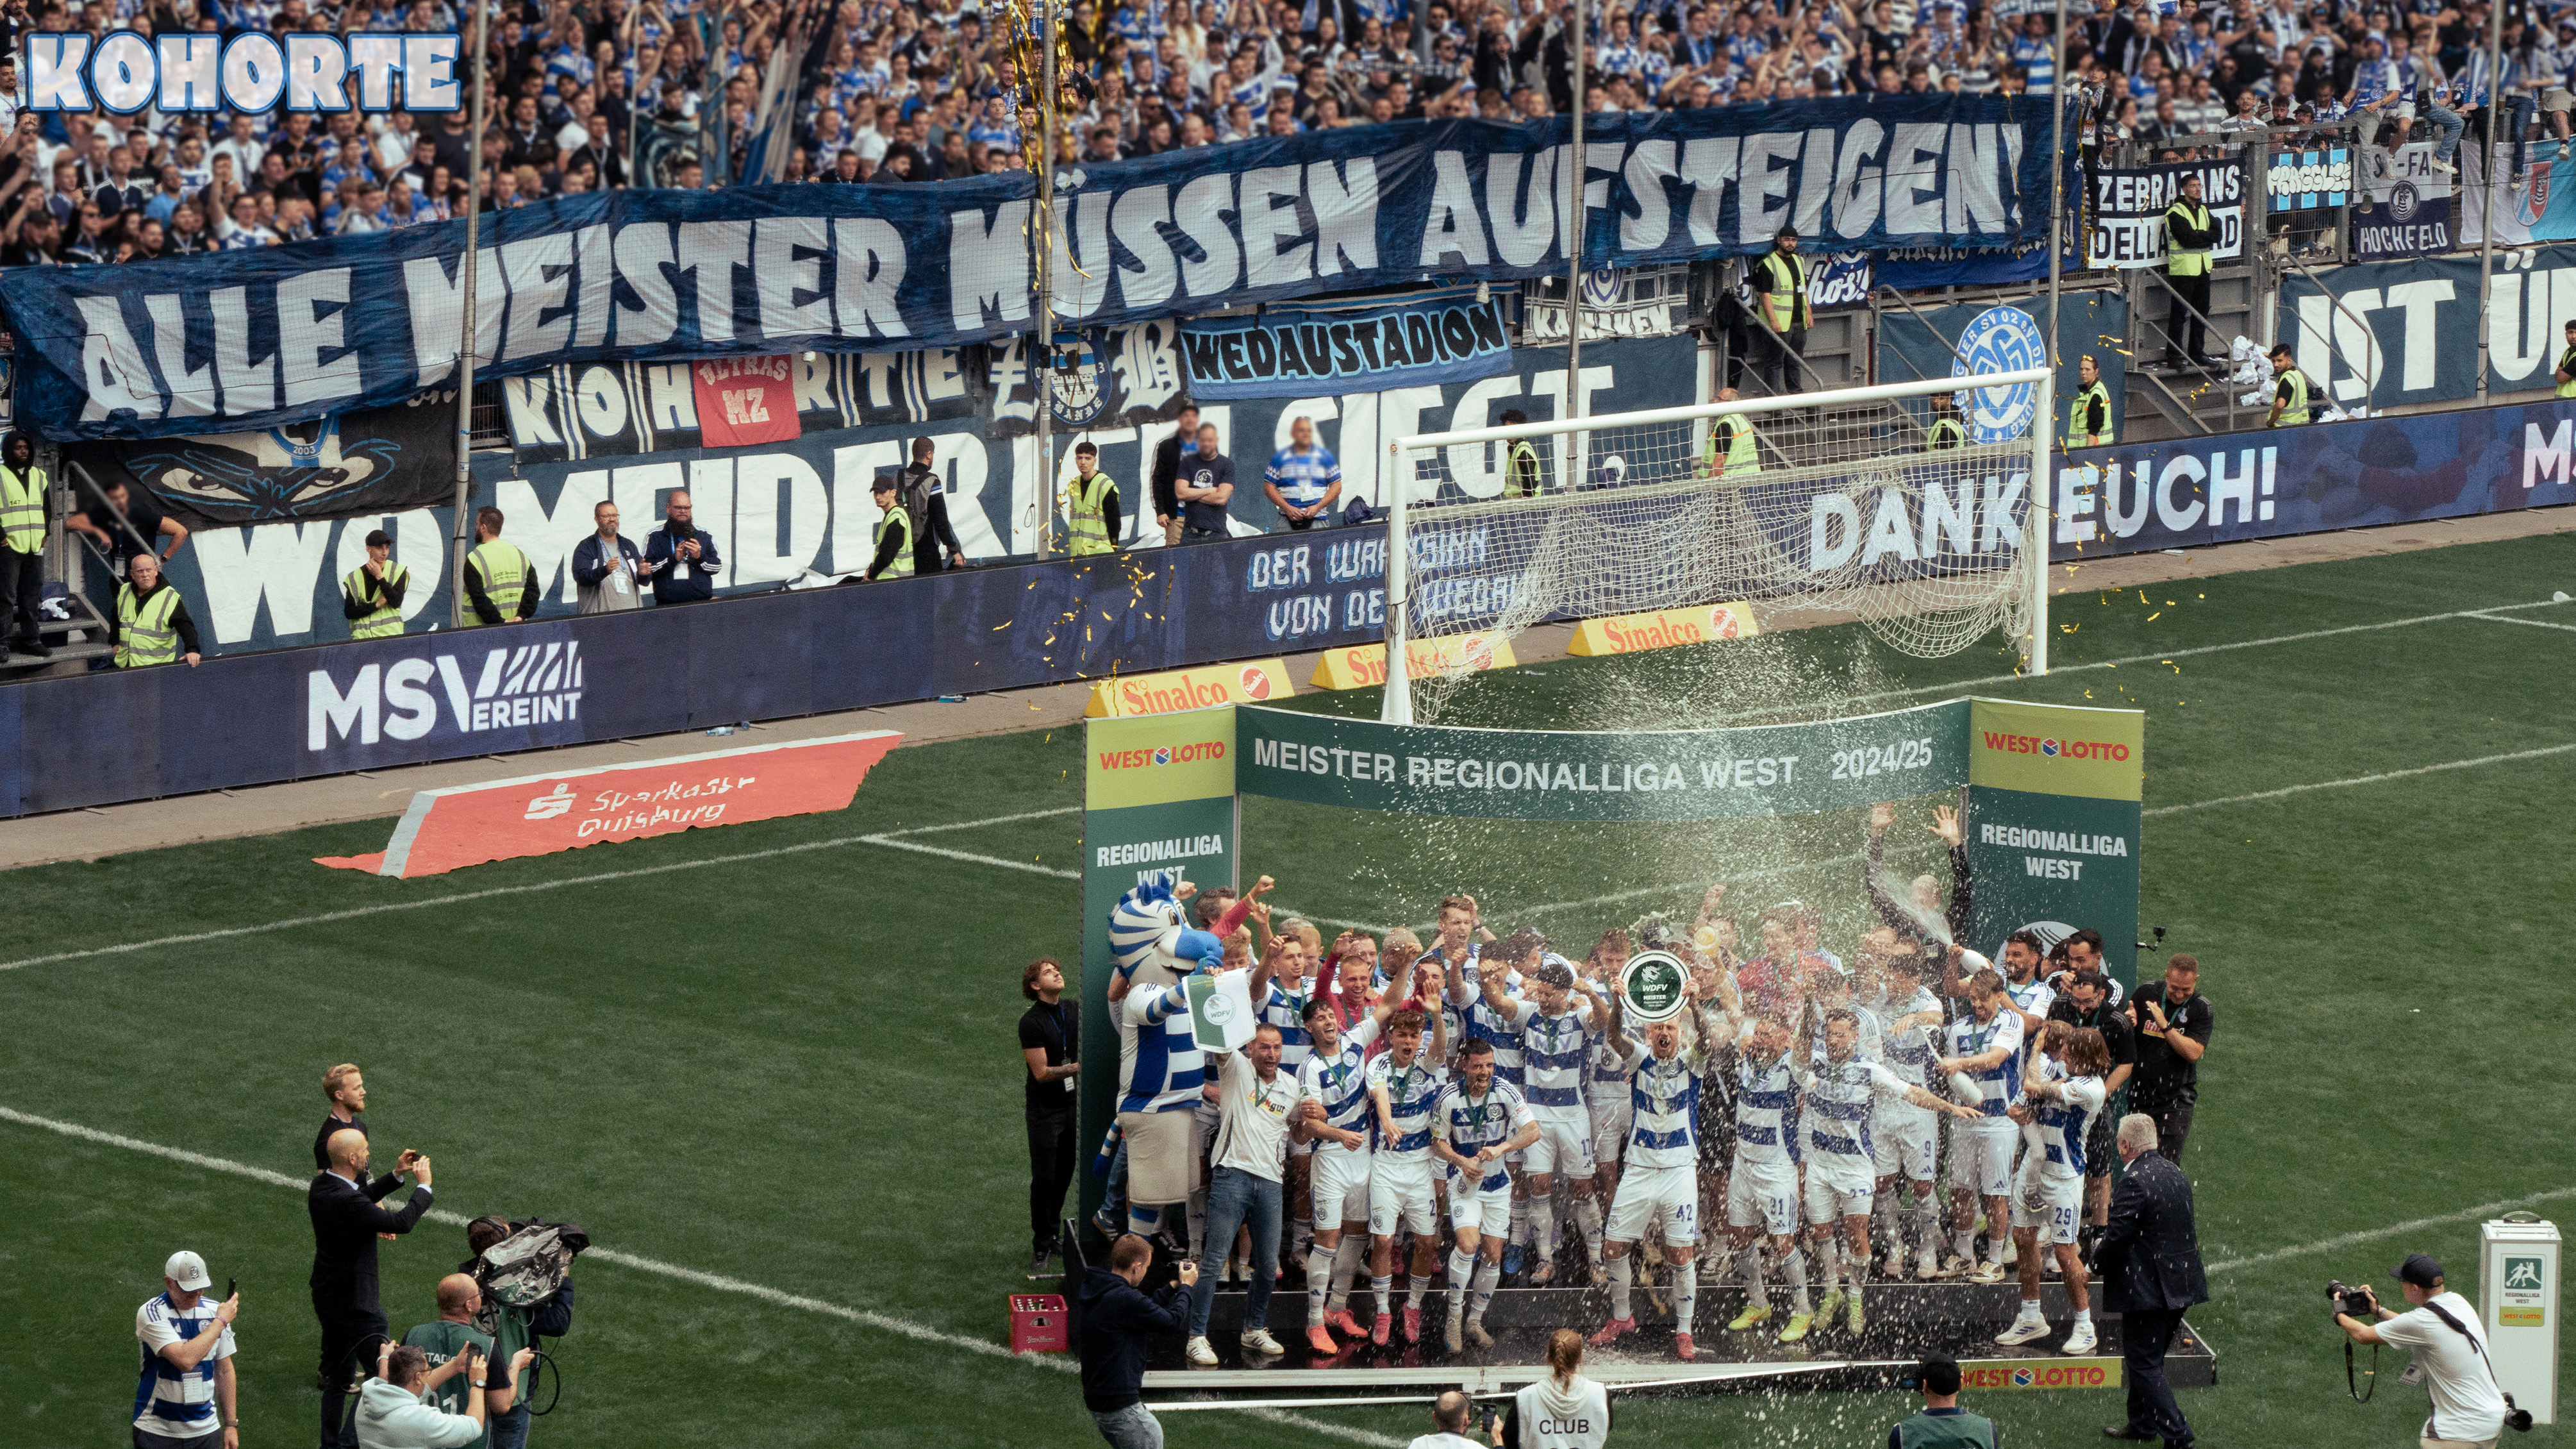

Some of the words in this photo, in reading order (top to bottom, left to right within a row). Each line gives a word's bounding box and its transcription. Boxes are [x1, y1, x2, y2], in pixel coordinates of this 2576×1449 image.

[2098, 164, 2240, 213] ZEBRAANS
[2359, 222, 2448, 254] HOCHFELD
[73, 267, 363, 422] ALLE
[403, 217, 911, 386] MEISTER
[951, 156, 1379, 331] MÜSSEN
[1418, 118, 2023, 267] AUFSTEIGEN!
[1981, 313, 1997, 331] SV
[2000, 310, 2018, 324] 02
[1182, 306, 1506, 383] WEDAUSTADION
[2297, 279, 2456, 401] IST
[698, 354, 789, 386] ULTRAS
[503, 347, 967, 448] KOHRTE
[722, 387, 770, 425] MZ
[292, 445, 316, 456] 2003
[2522, 418, 2576, 489] M
[1810, 473, 2031, 573] DANK
[2057, 446, 2277, 544] EUCH!
[192, 507, 444, 644] WO
[1249, 544, 1311, 590] DER
[1267, 594, 1332, 640] VON
[1344, 587, 1385, 631] DE
[1604, 614, 1701, 654] Sinalco
[1347, 644, 1450, 685] Silco
[308, 647, 508, 751] MSV
[472, 692, 582, 732] EREINT
[1122, 674, 1229, 716] Sinalco
[1099, 748, 1154, 771] WEST
[1170, 741, 1226, 764] LOTTO
[1254, 737, 1396, 783] MEISTER
[1408, 755, 1687, 792] REGIONALLIGA
[1699, 756, 1799, 790] WEST
[1831, 737, 1933, 781] 2024/25
[1983, 730, 2041, 755] WEST
[2060, 739, 2131, 762] LOTTO
[1096, 834, 1224, 867] REGIONALLIGA
[1981, 823, 2128, 857] REGIONALLIGA
[2025, 856, 2083, 881] WEST
[1642, 984, 1668, 992] WDFV
[1211, 1009, 1231, 1019] WDFV
[1676, 1203, 1693, 1222] 42
[2055, 1207, 2072, 1225] 29
[2034, 1366, 2106, 1386] LOTTO
[1539, 1419, 1590, 1435] CLUB
